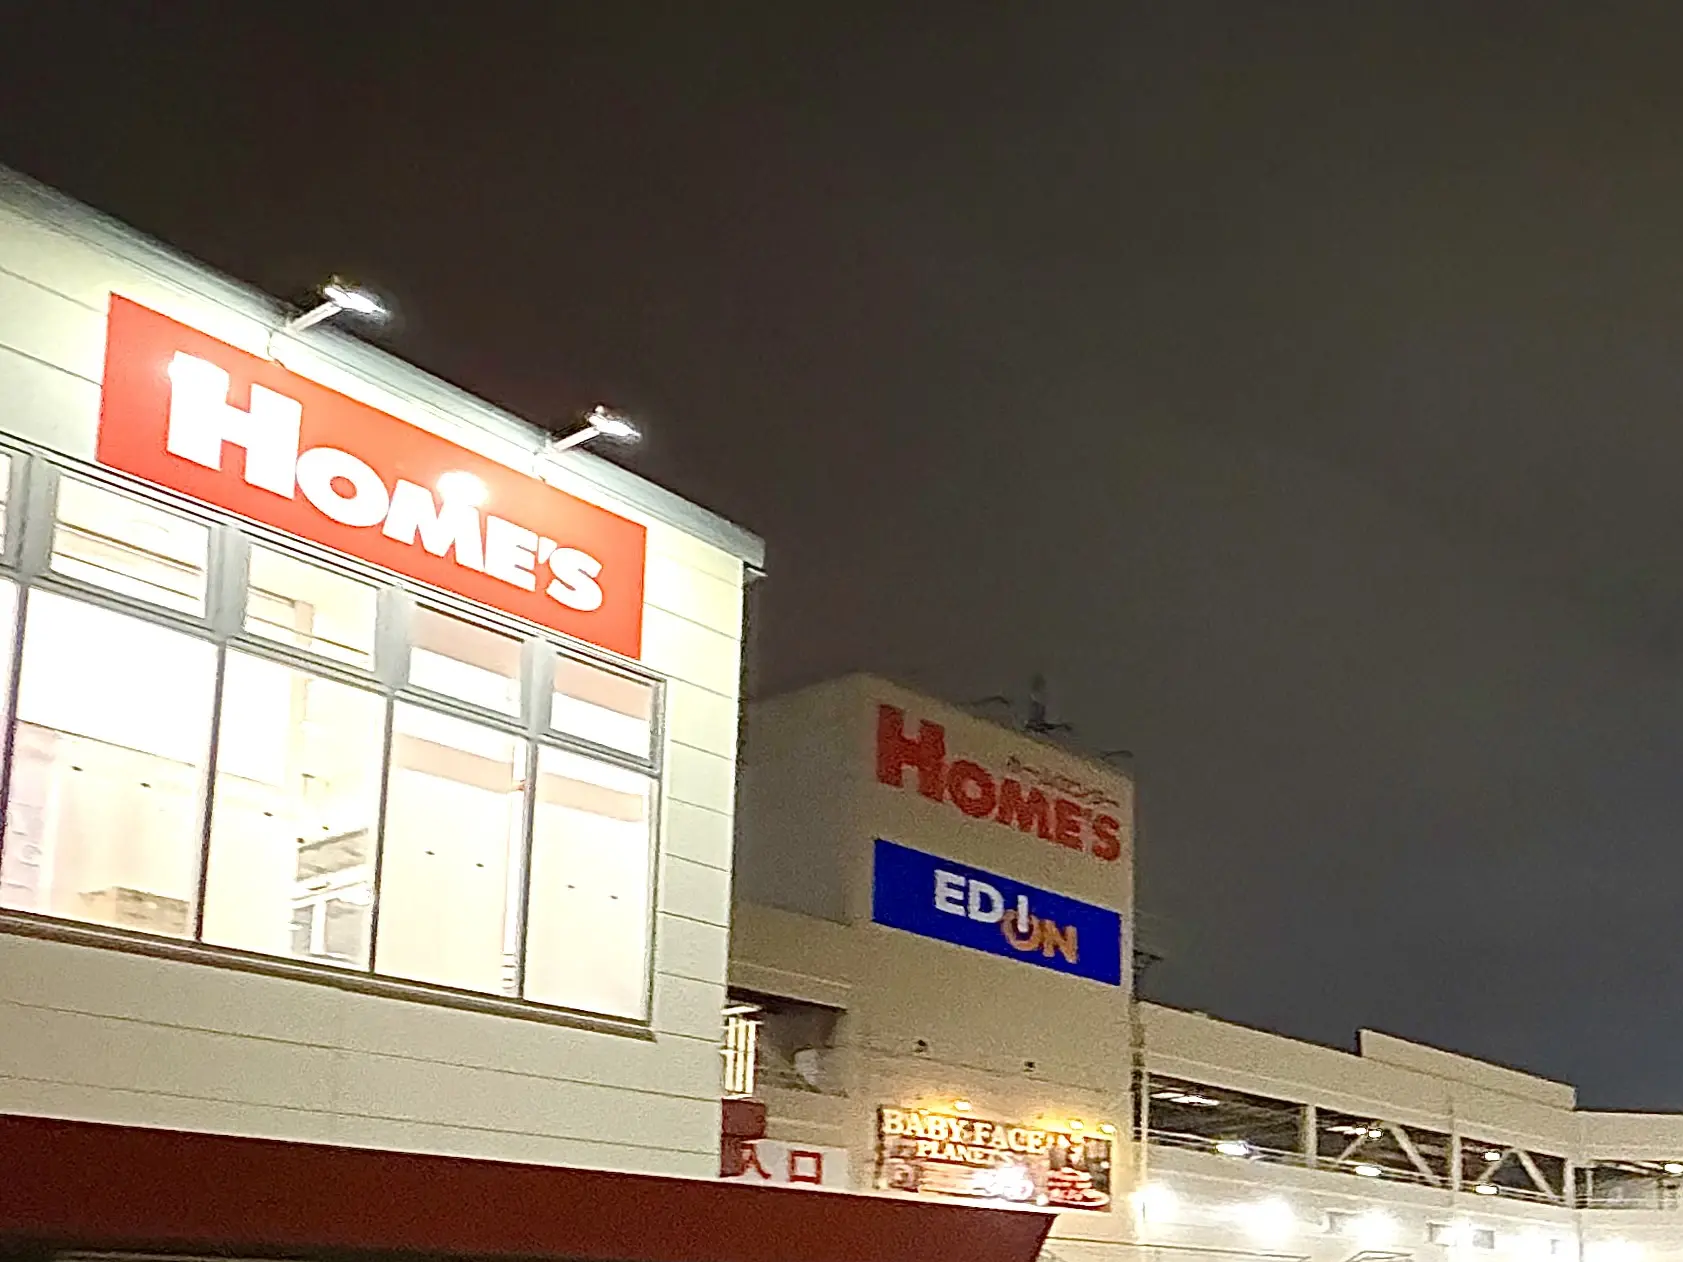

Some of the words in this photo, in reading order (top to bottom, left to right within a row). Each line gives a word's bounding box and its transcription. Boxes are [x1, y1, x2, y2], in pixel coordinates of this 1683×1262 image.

[168, 351, 602, 611] HOME'S
[877, 704, 1121, 861] HOME'S
[934, 869, 1077, 964] EDION
